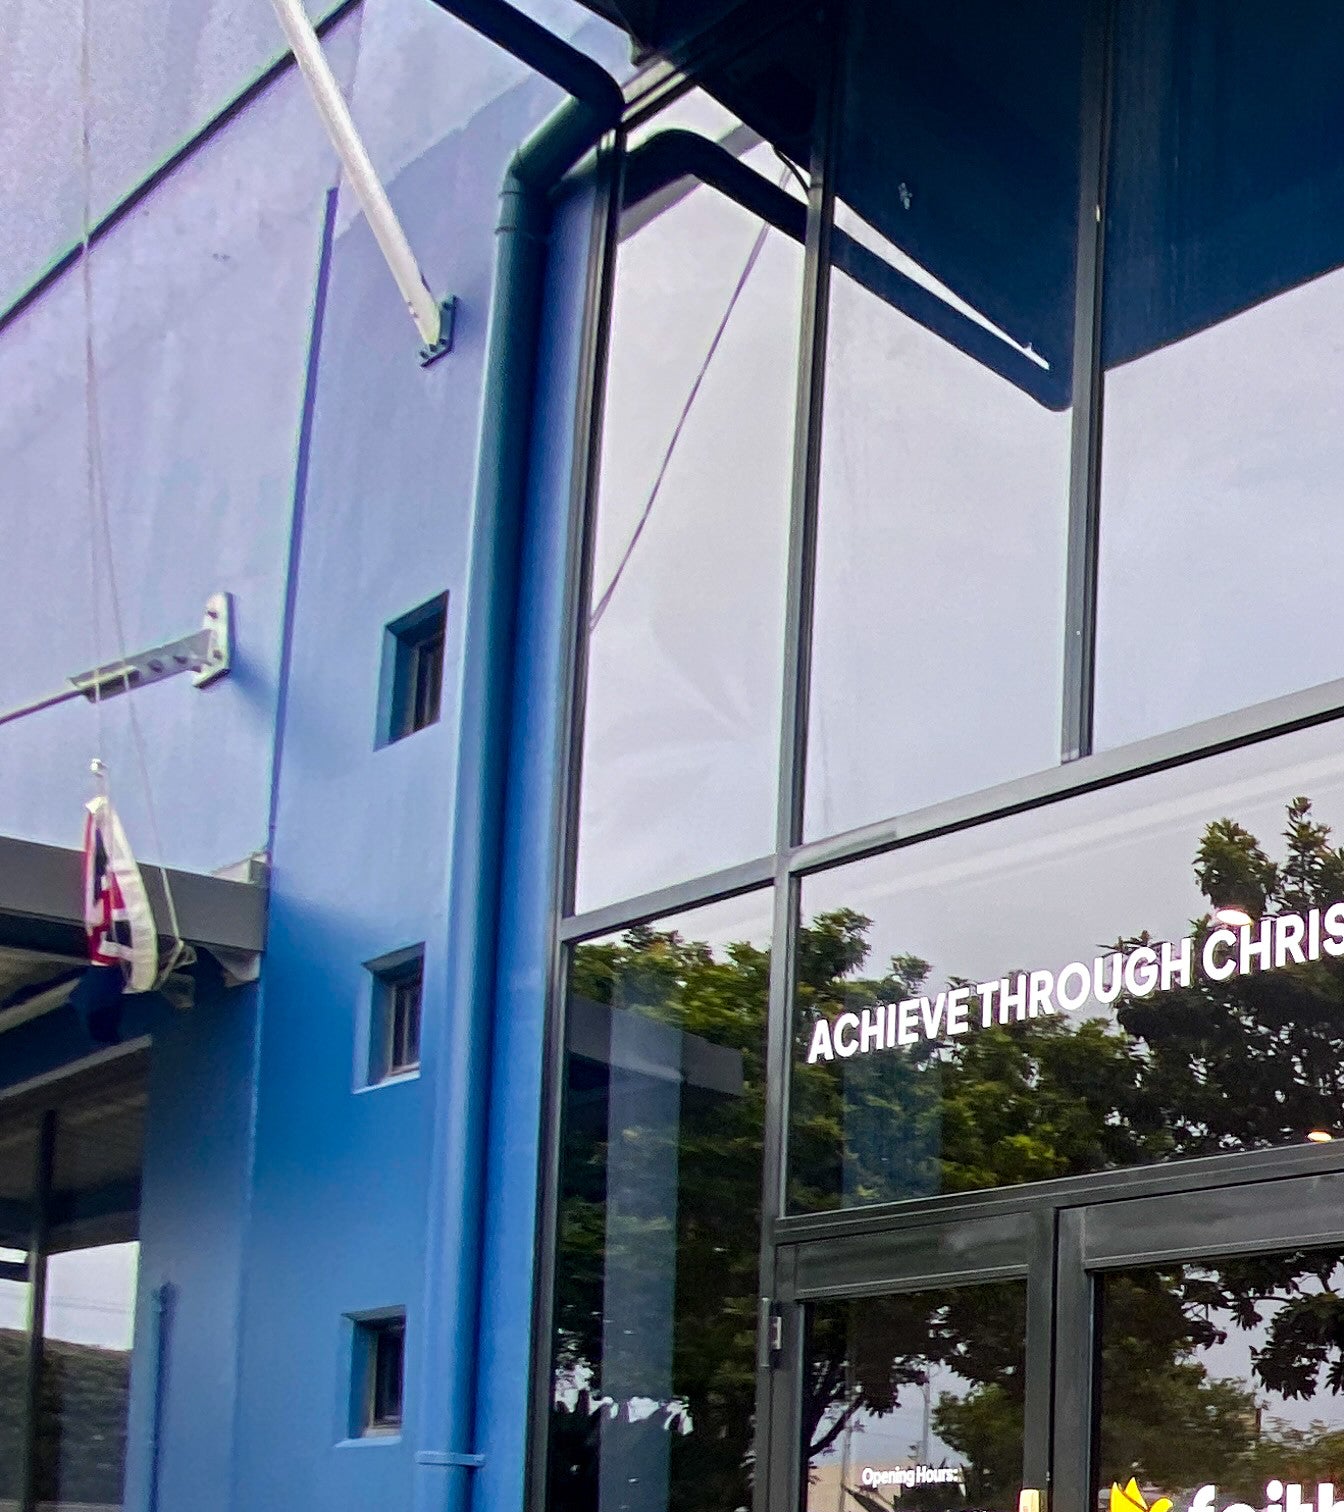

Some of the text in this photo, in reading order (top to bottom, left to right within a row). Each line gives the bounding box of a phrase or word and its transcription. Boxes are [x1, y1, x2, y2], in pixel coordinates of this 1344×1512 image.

[807, 991, 971, 1065] ACHIEVE
[974, 936, 1193, 1030] THROUGH
[862, 1465, 959, 1488] Opening Hours:
